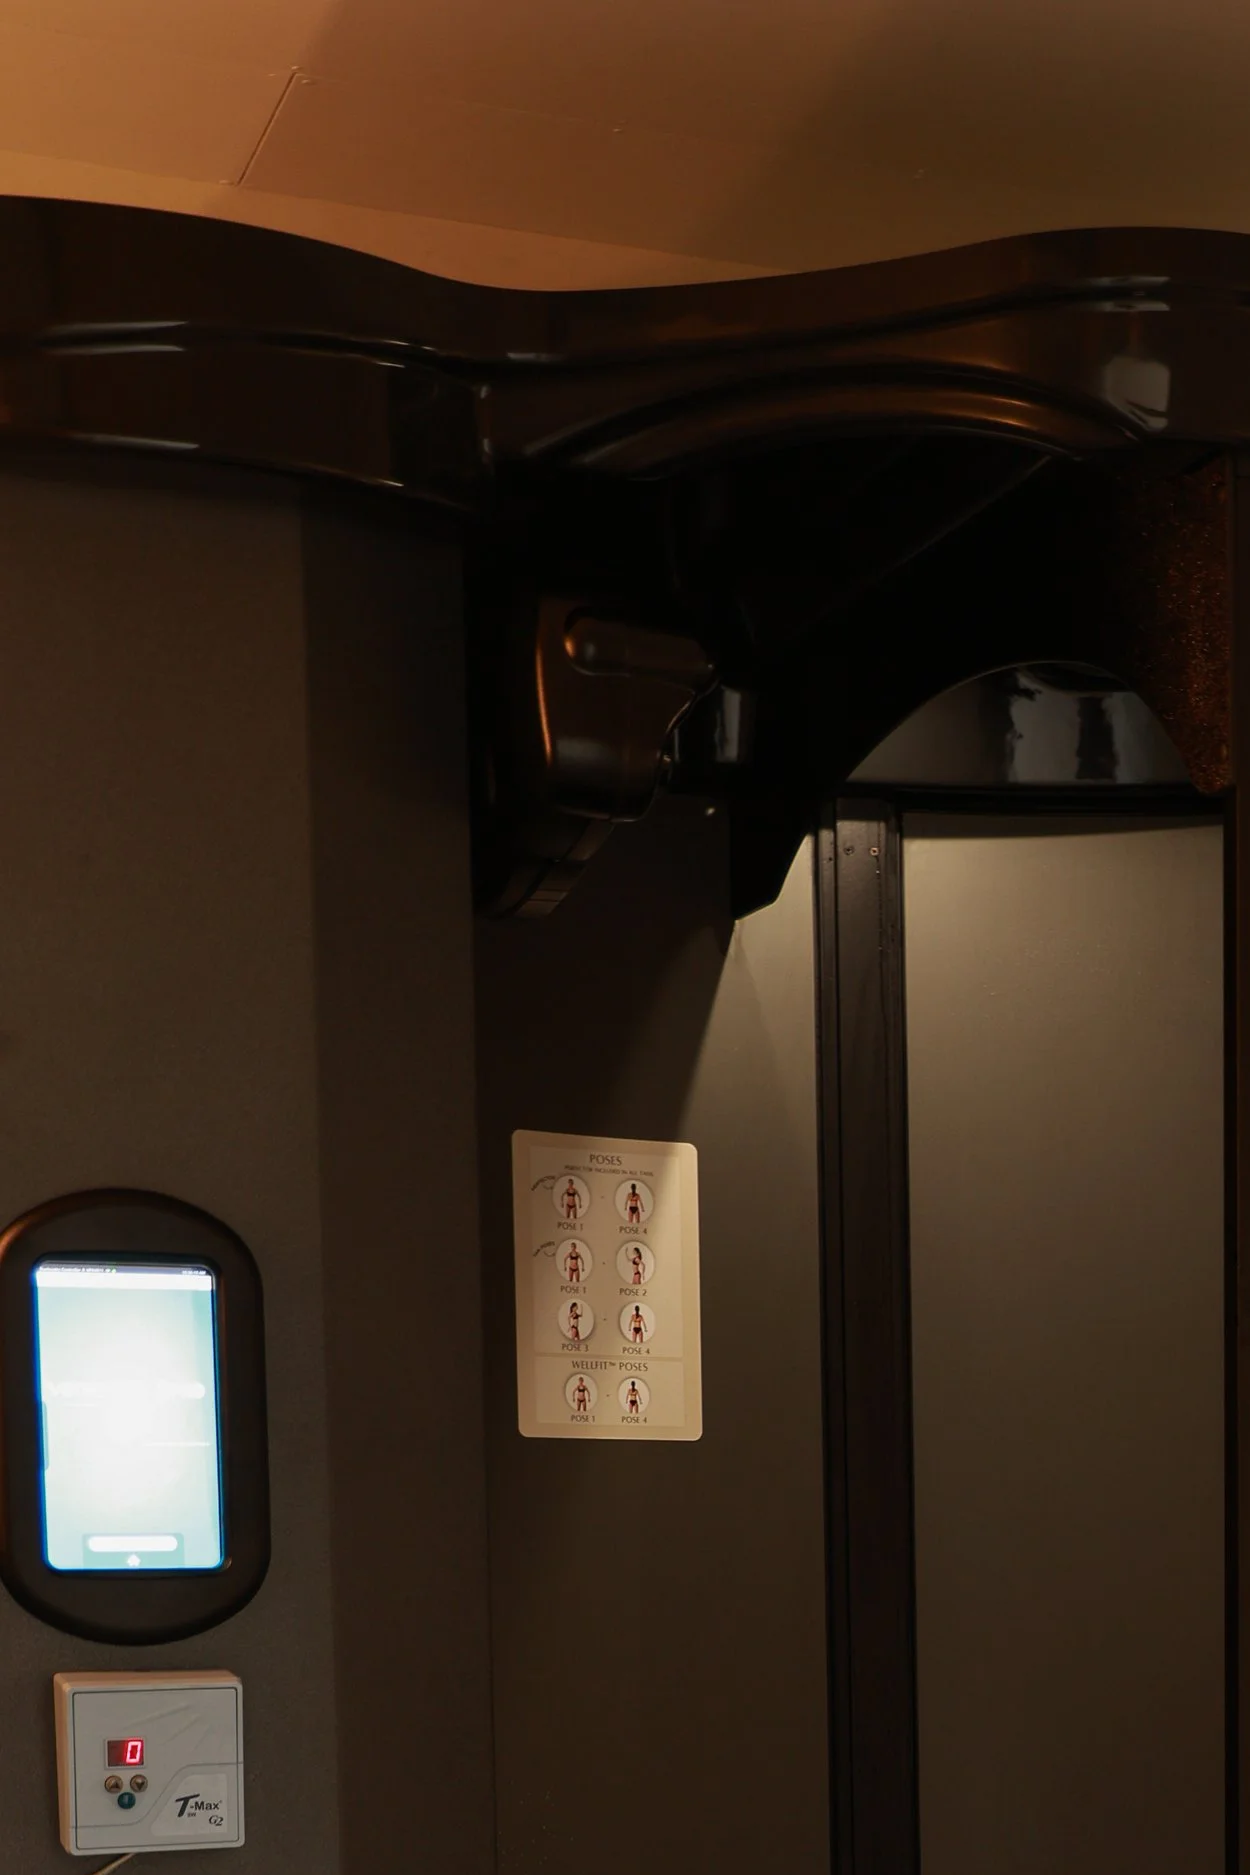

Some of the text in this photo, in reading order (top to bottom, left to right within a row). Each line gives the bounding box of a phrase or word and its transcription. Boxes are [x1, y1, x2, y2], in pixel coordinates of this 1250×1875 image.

[589, 1154, 622, 1166] POSES
[557, 1222, 576, 1231] POSE
[619, 1226, 640, 1234] POSE
[560, 1285, 579, 1294] POSE
[619, 1288, 639, 1296] POSE
[561, 1343, 581, 1352] POSE
[622, 1347, 641, 1355] POSE
[619, 1362, 648, 1372] POSES
[621, 1416, 641, 1424] POSE
[126, 1741, 142, 1764] 0
[175, 1793, 220, 1818] T-Max
[208, 1815, 224, 1827] G2
